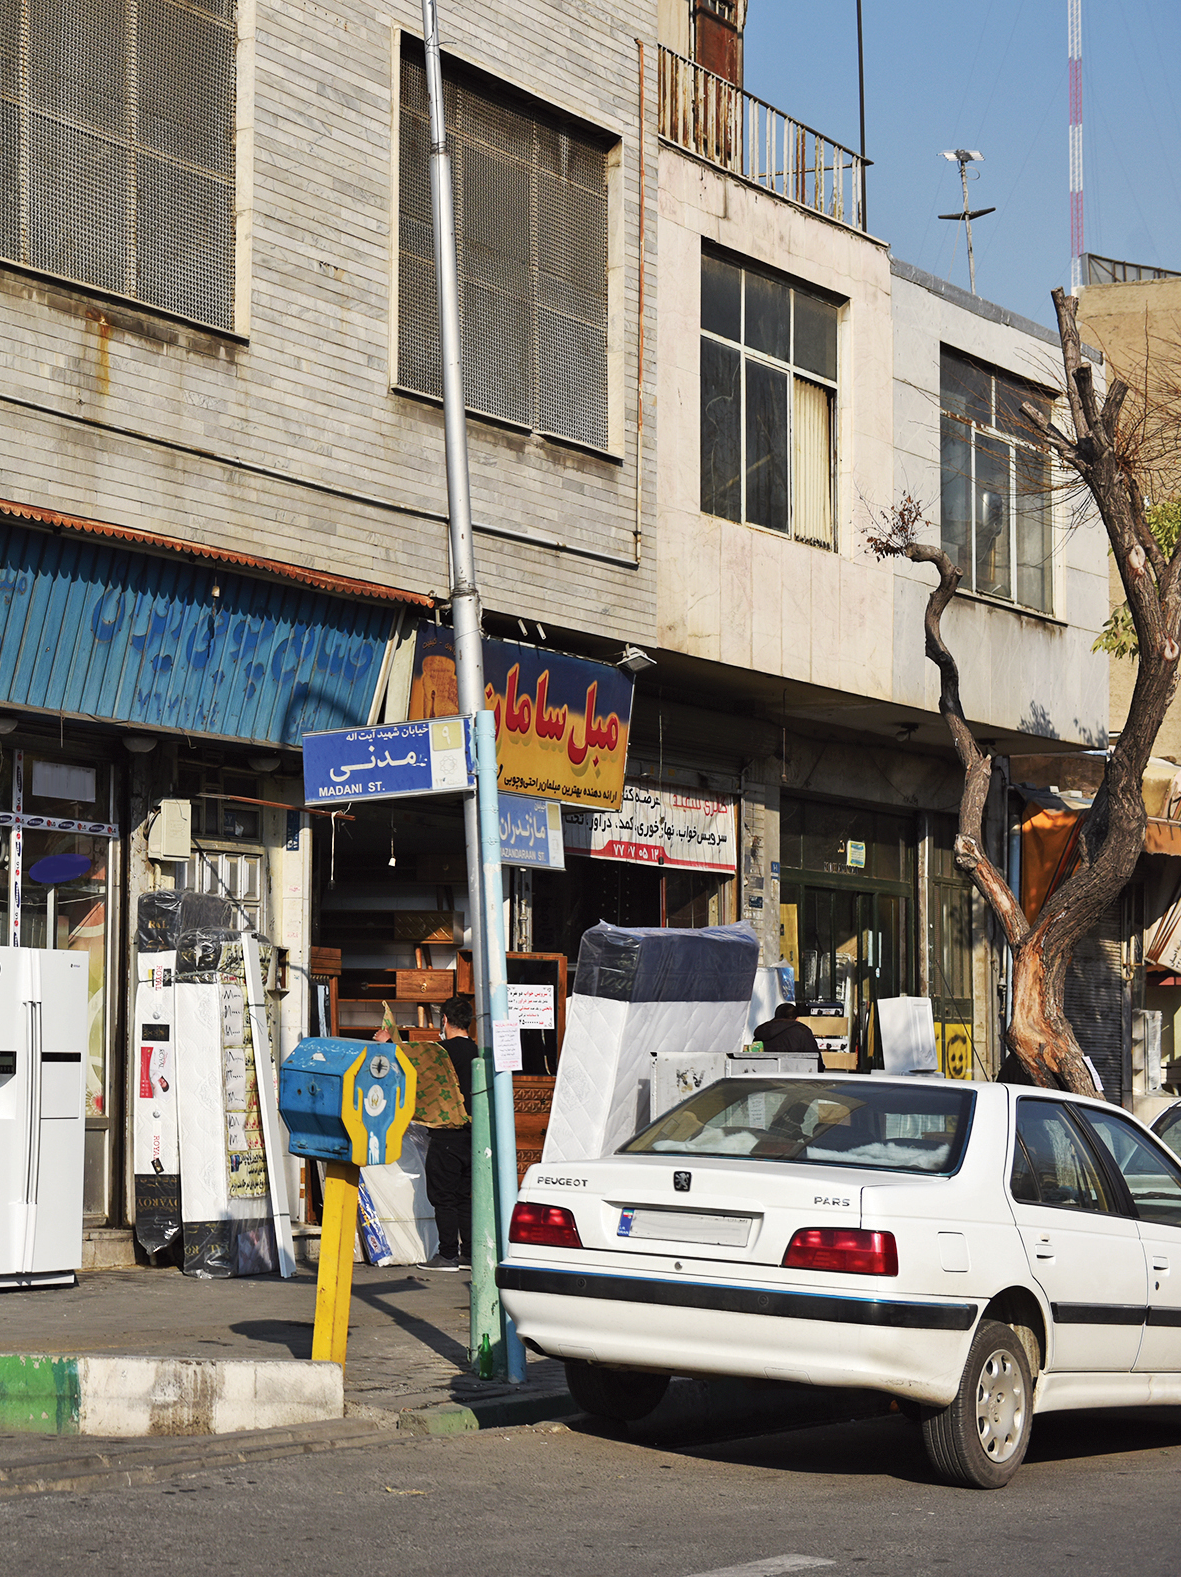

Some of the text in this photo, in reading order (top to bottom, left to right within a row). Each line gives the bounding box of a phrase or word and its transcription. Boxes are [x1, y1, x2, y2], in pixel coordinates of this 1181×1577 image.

[568, 680, 619, 767] مبل
[346, 723, 429, 742] خیابان شهید آیت اله
[442, 725, 451, 745] ۹
[329, 745, 417, 782] مدنی
[319, 781, 385, 797] MADANI ST.
[541, 779, 561, 794] مبلمان
[562, 785, 582, 797] بهترین
[583, 788, 601, 798] دهنده
[603, 791, 617, 803] ارائه
[623, 788, 661, 809] عرضه کن
[499, 812, 546, 847] مازندران
[697, 832, 727, 846] سرویس
[155, 965, 163, 991] ROYAL
[537, 1176, 588, 1187] PEUGEOT
[814, 1196, 850, 1207] PARS
